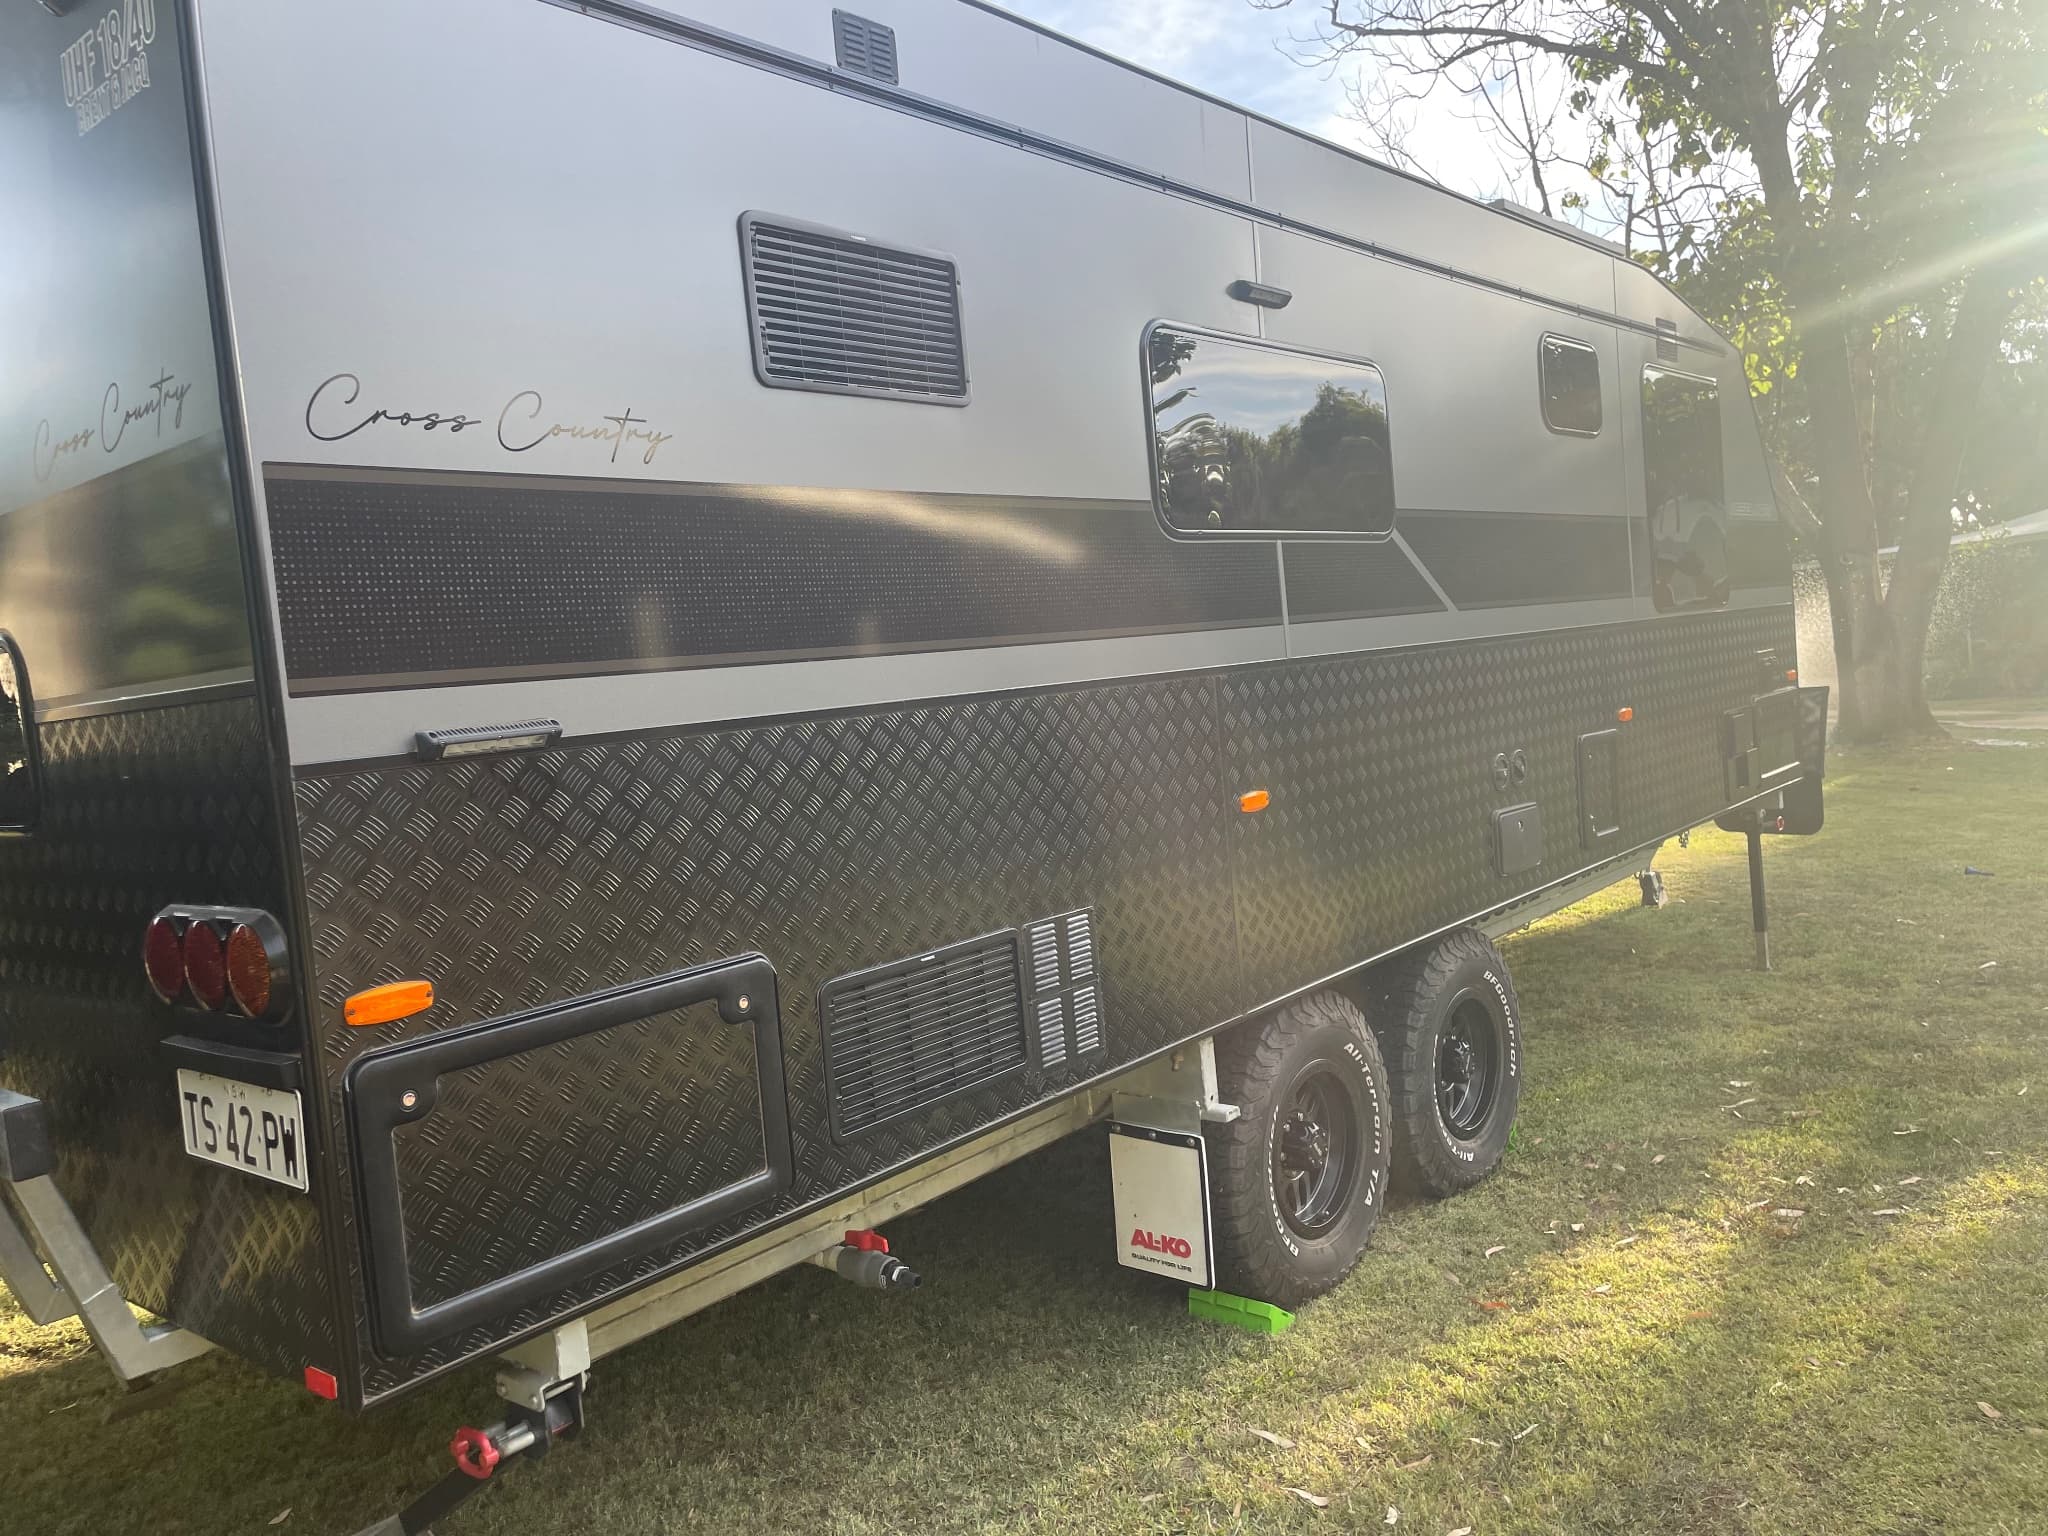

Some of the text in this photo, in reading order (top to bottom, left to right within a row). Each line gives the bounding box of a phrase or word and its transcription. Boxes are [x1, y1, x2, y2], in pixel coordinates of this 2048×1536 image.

[60, 0, 156, 107] UHF 18/40
[33, 367, 192, 483] Cross Country
[305, 373, 673, 464] Cross Country
[1483, 969, 1516, 1077] BFGoodrich
[1343, 1042, 1382, 1207] All-Terrain T/A
[1131, 1228, 1192, 1259] AL-KO
[1131, 1252, 1161, 1264] QUALITY
